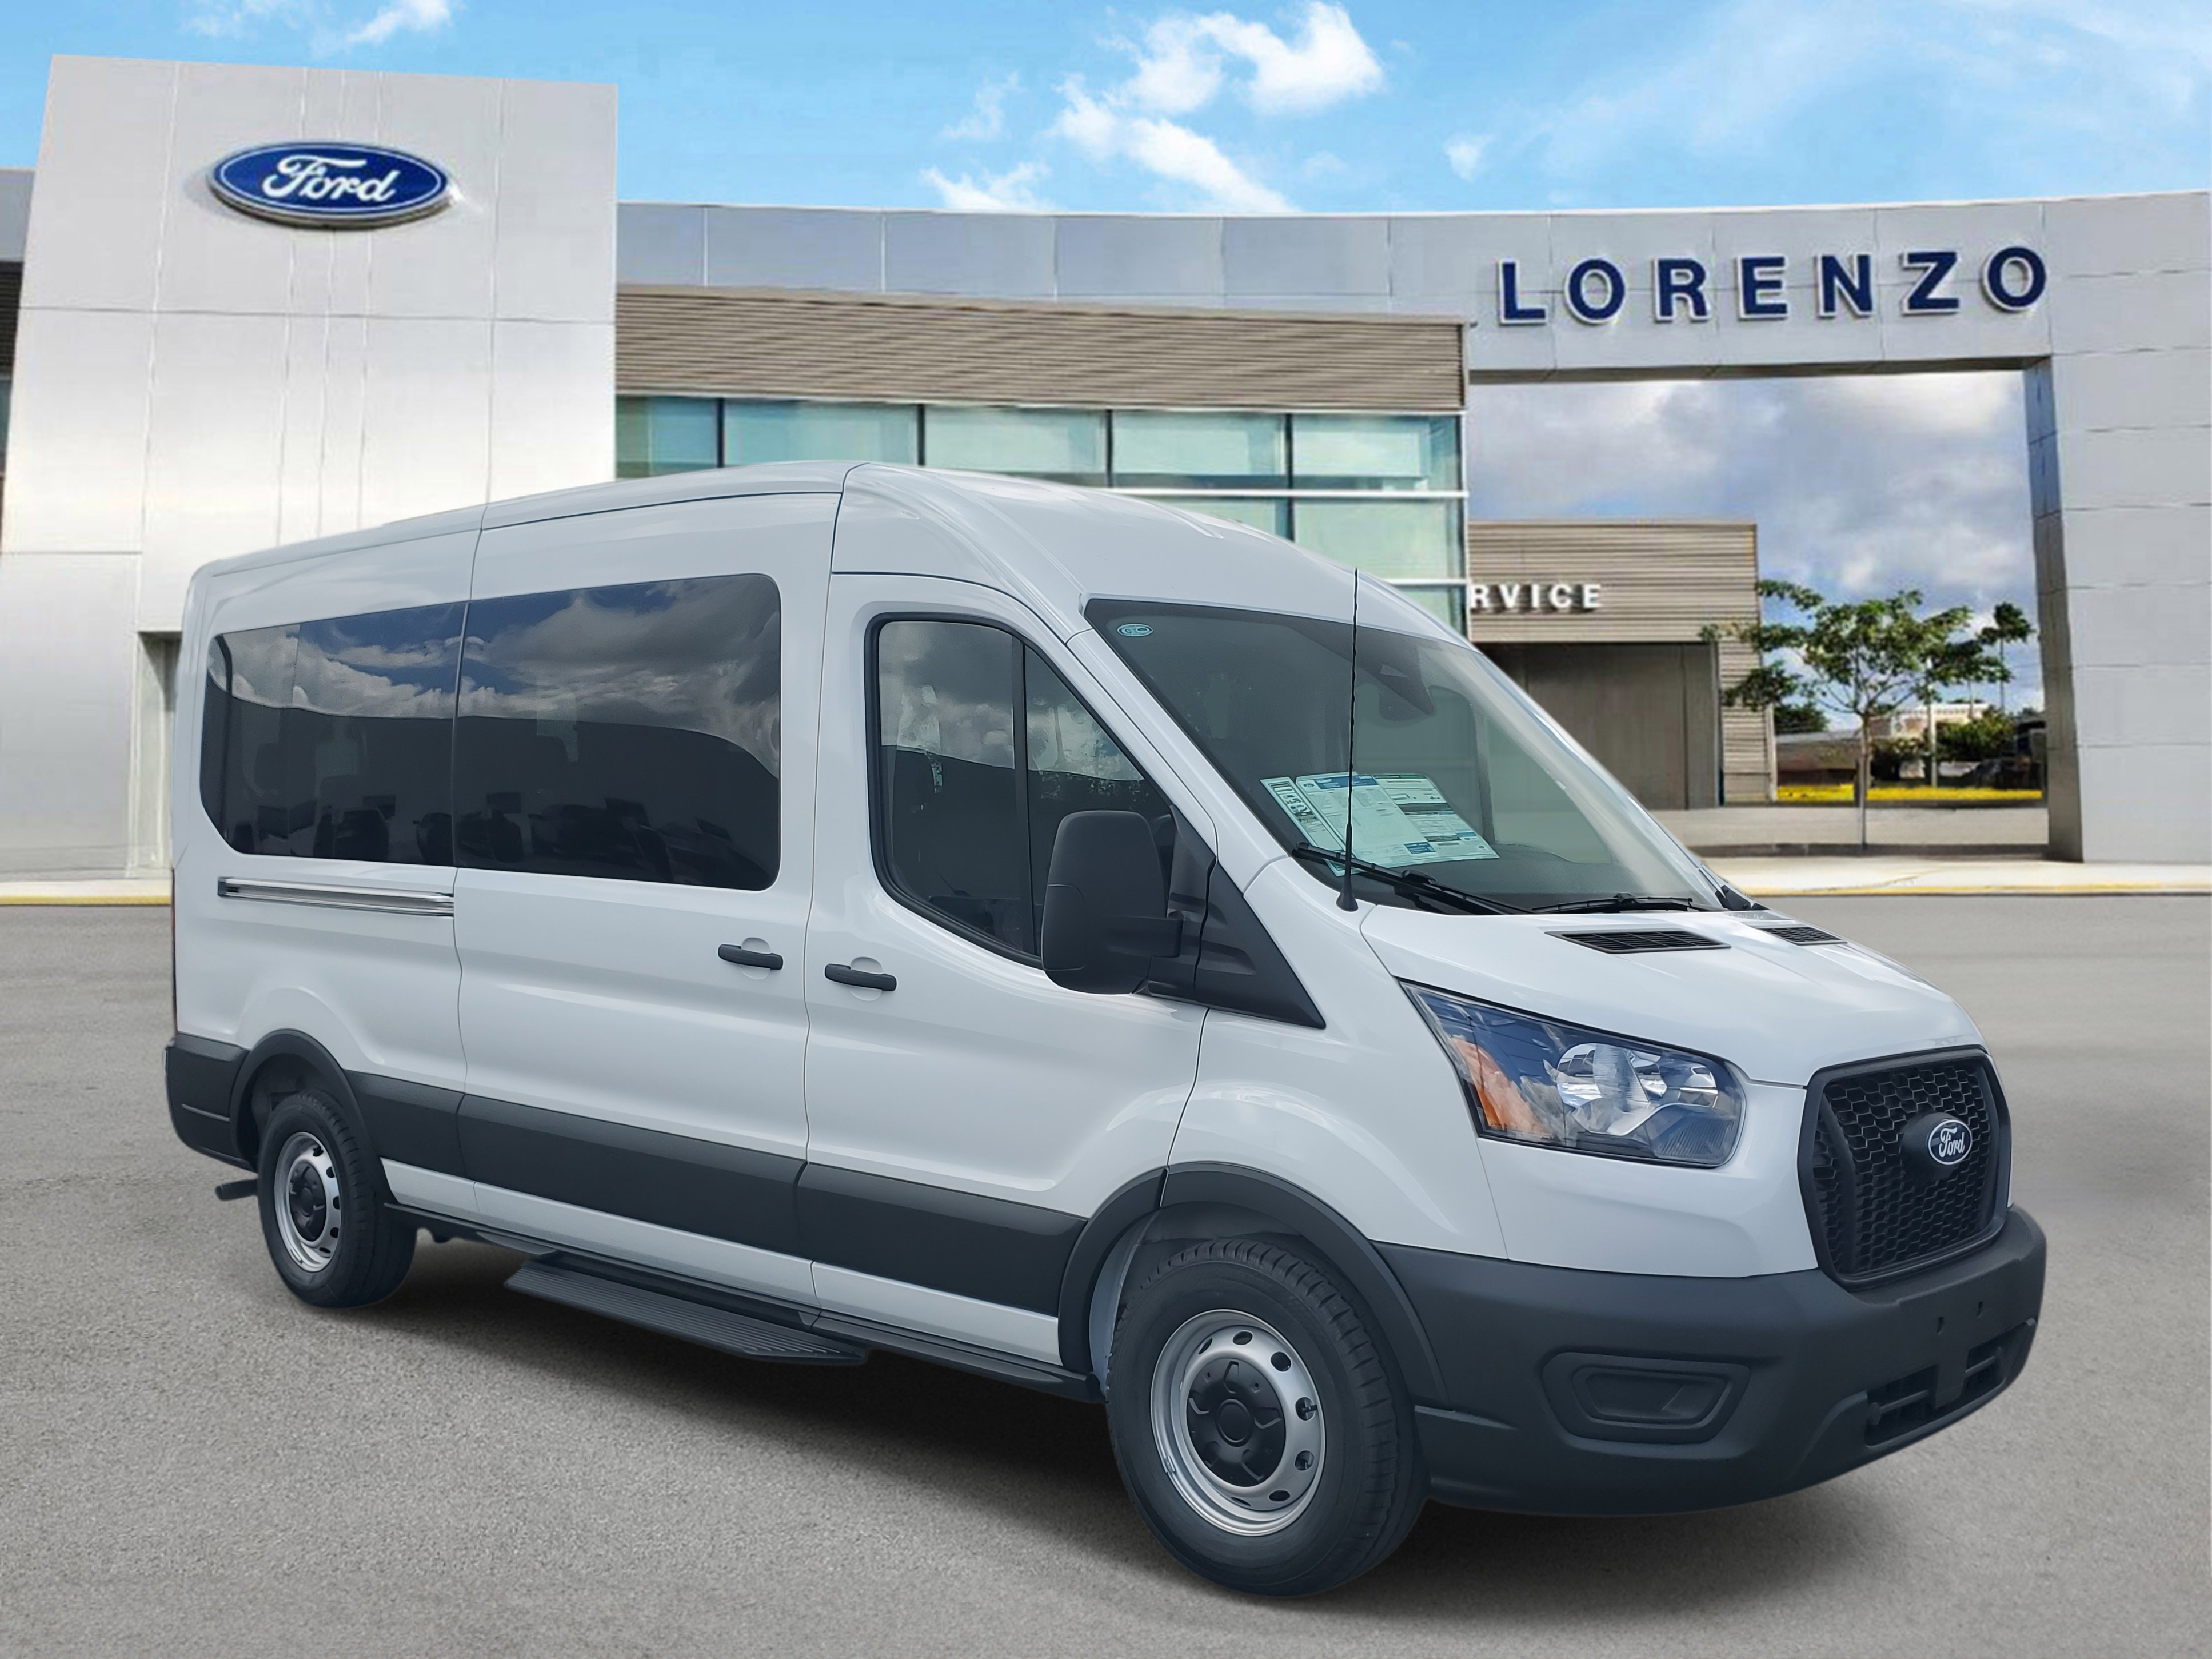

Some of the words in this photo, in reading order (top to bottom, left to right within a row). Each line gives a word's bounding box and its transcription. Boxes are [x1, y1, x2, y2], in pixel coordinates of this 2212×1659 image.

[262, 155, 400, 202] Ford
[1498, 246, 2046, 324] LORENZO
[1938, 1127, 1965, 1158] Ford
